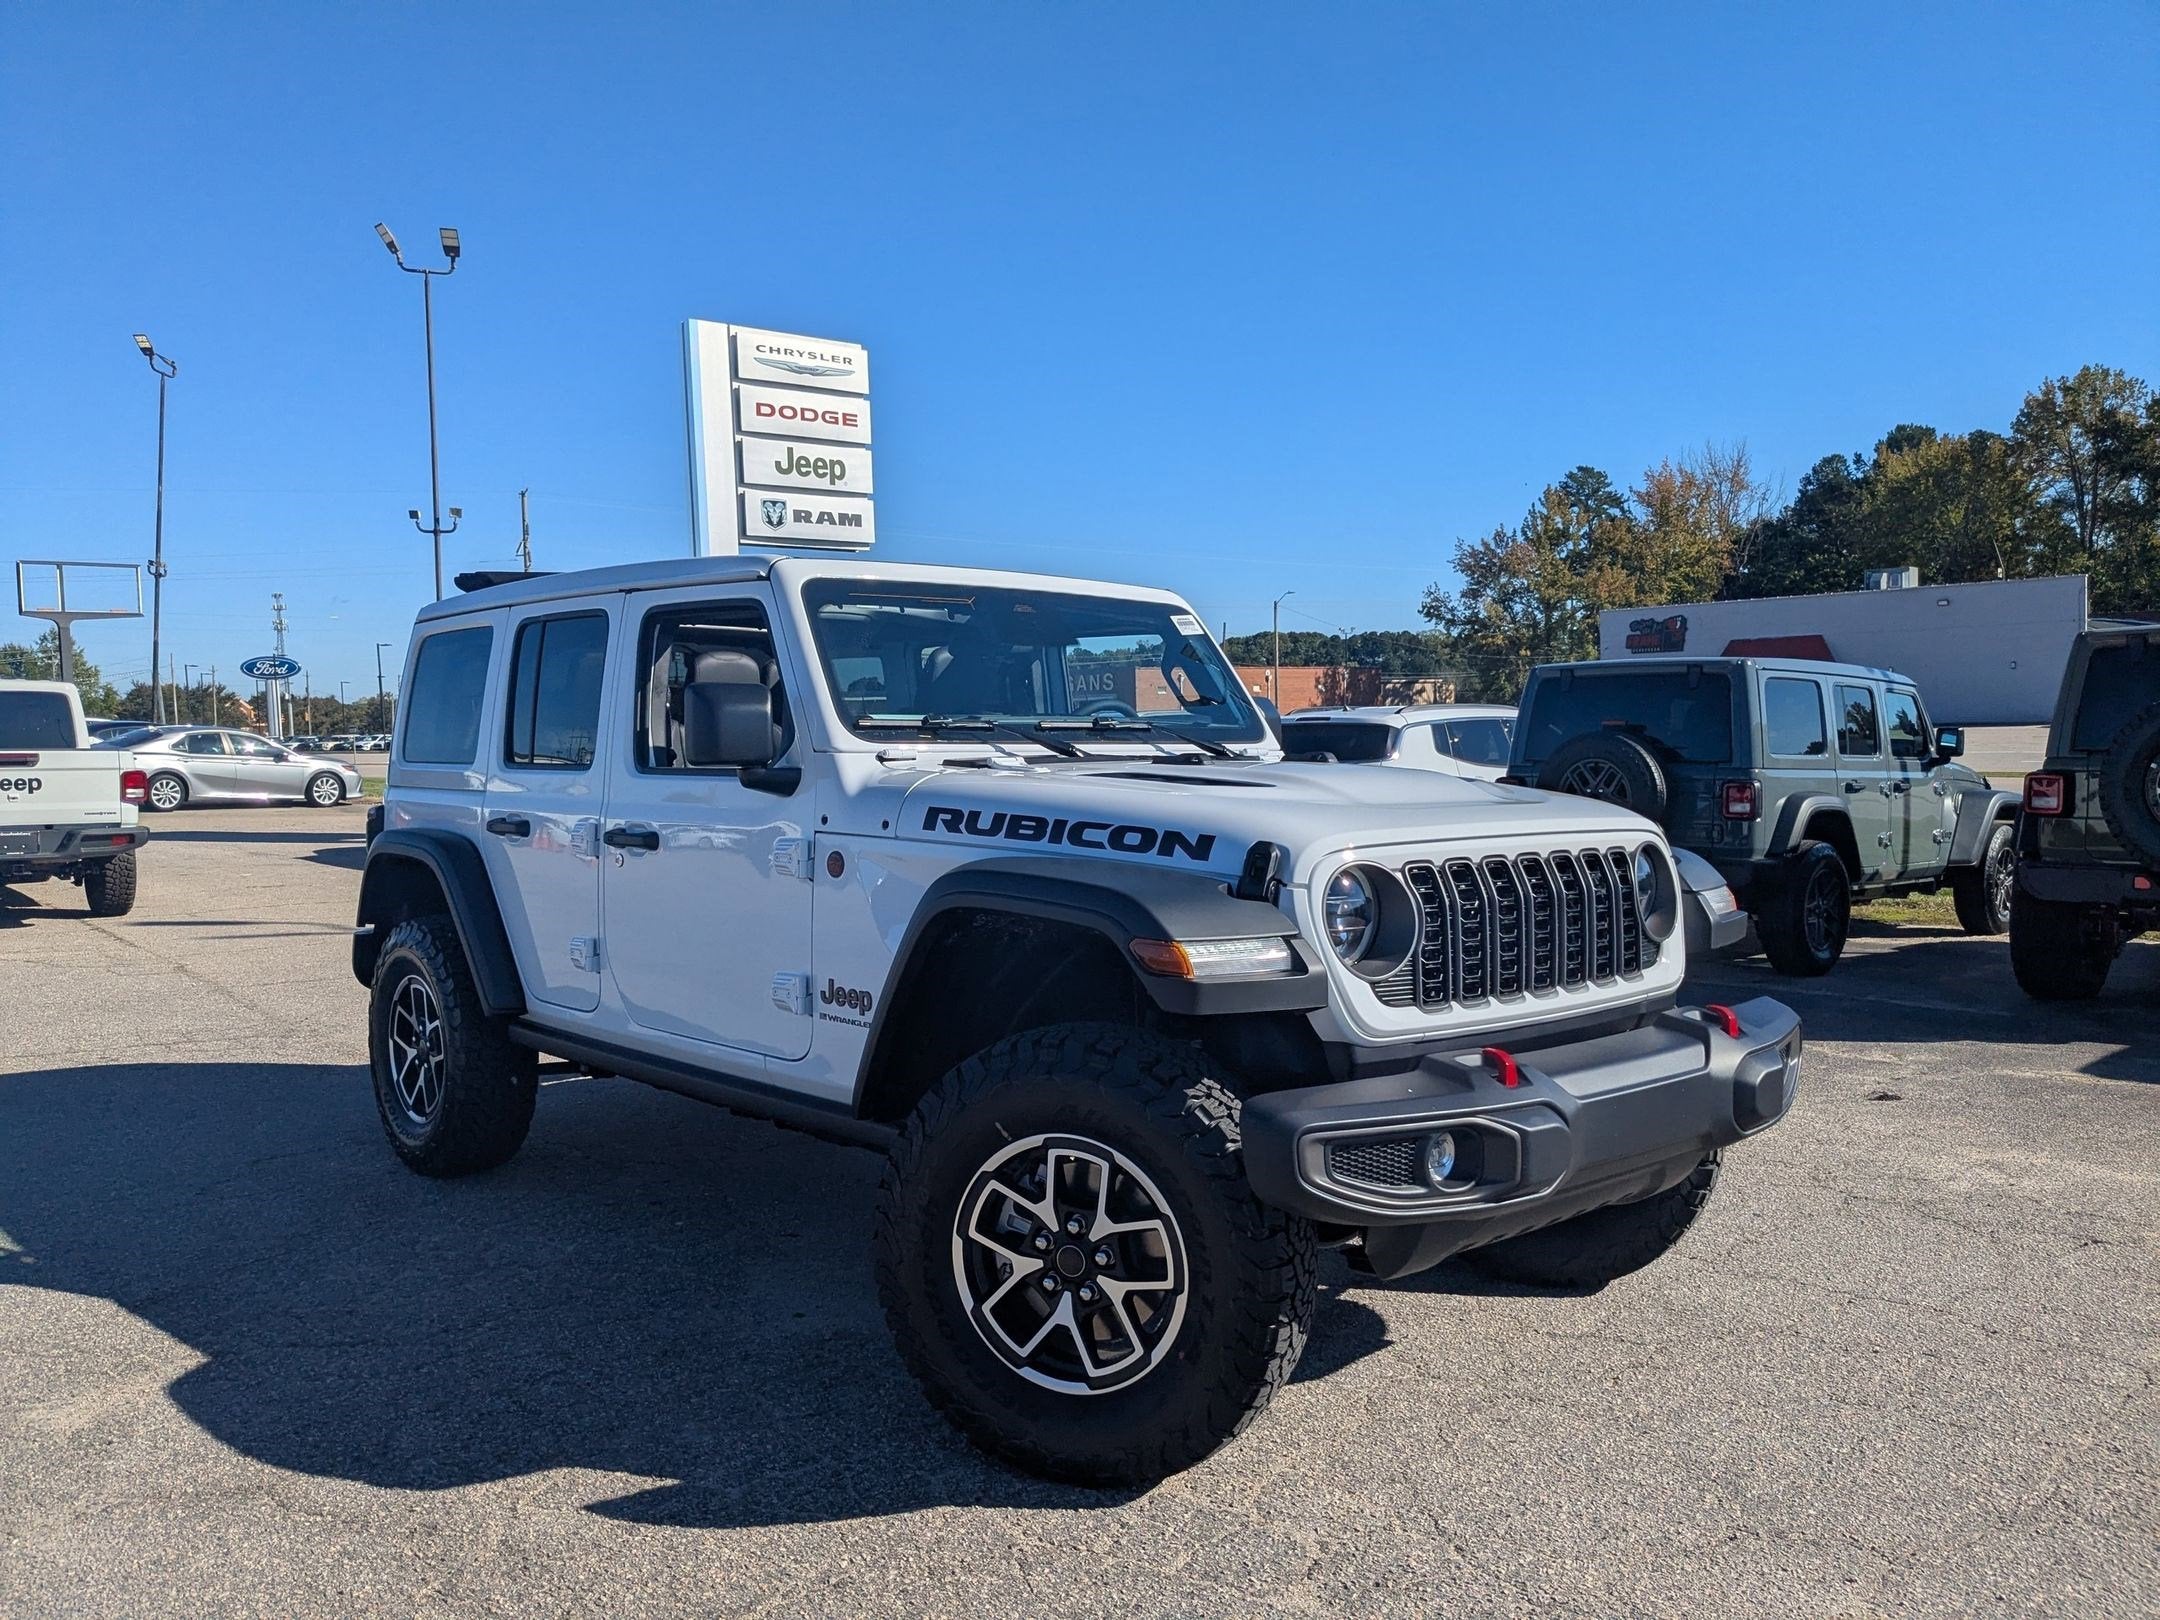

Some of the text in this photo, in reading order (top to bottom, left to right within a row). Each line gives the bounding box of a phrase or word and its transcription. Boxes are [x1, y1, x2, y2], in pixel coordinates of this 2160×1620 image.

[755, 344, 853, 365] CHRYSLER
[755, 402, 859, 427] DODGE
[774, 446, 846, 485] Jeep
[793, 509, 862, 527] RAM
[253, 660, 289, 674] Ford
[0, 777, 42, 794] eep
[922, 806, 1216, 861] RUBICON
[820, 978, 873, 1017] Jeep
[827, 1013, 871, 1029] WRANGLE
